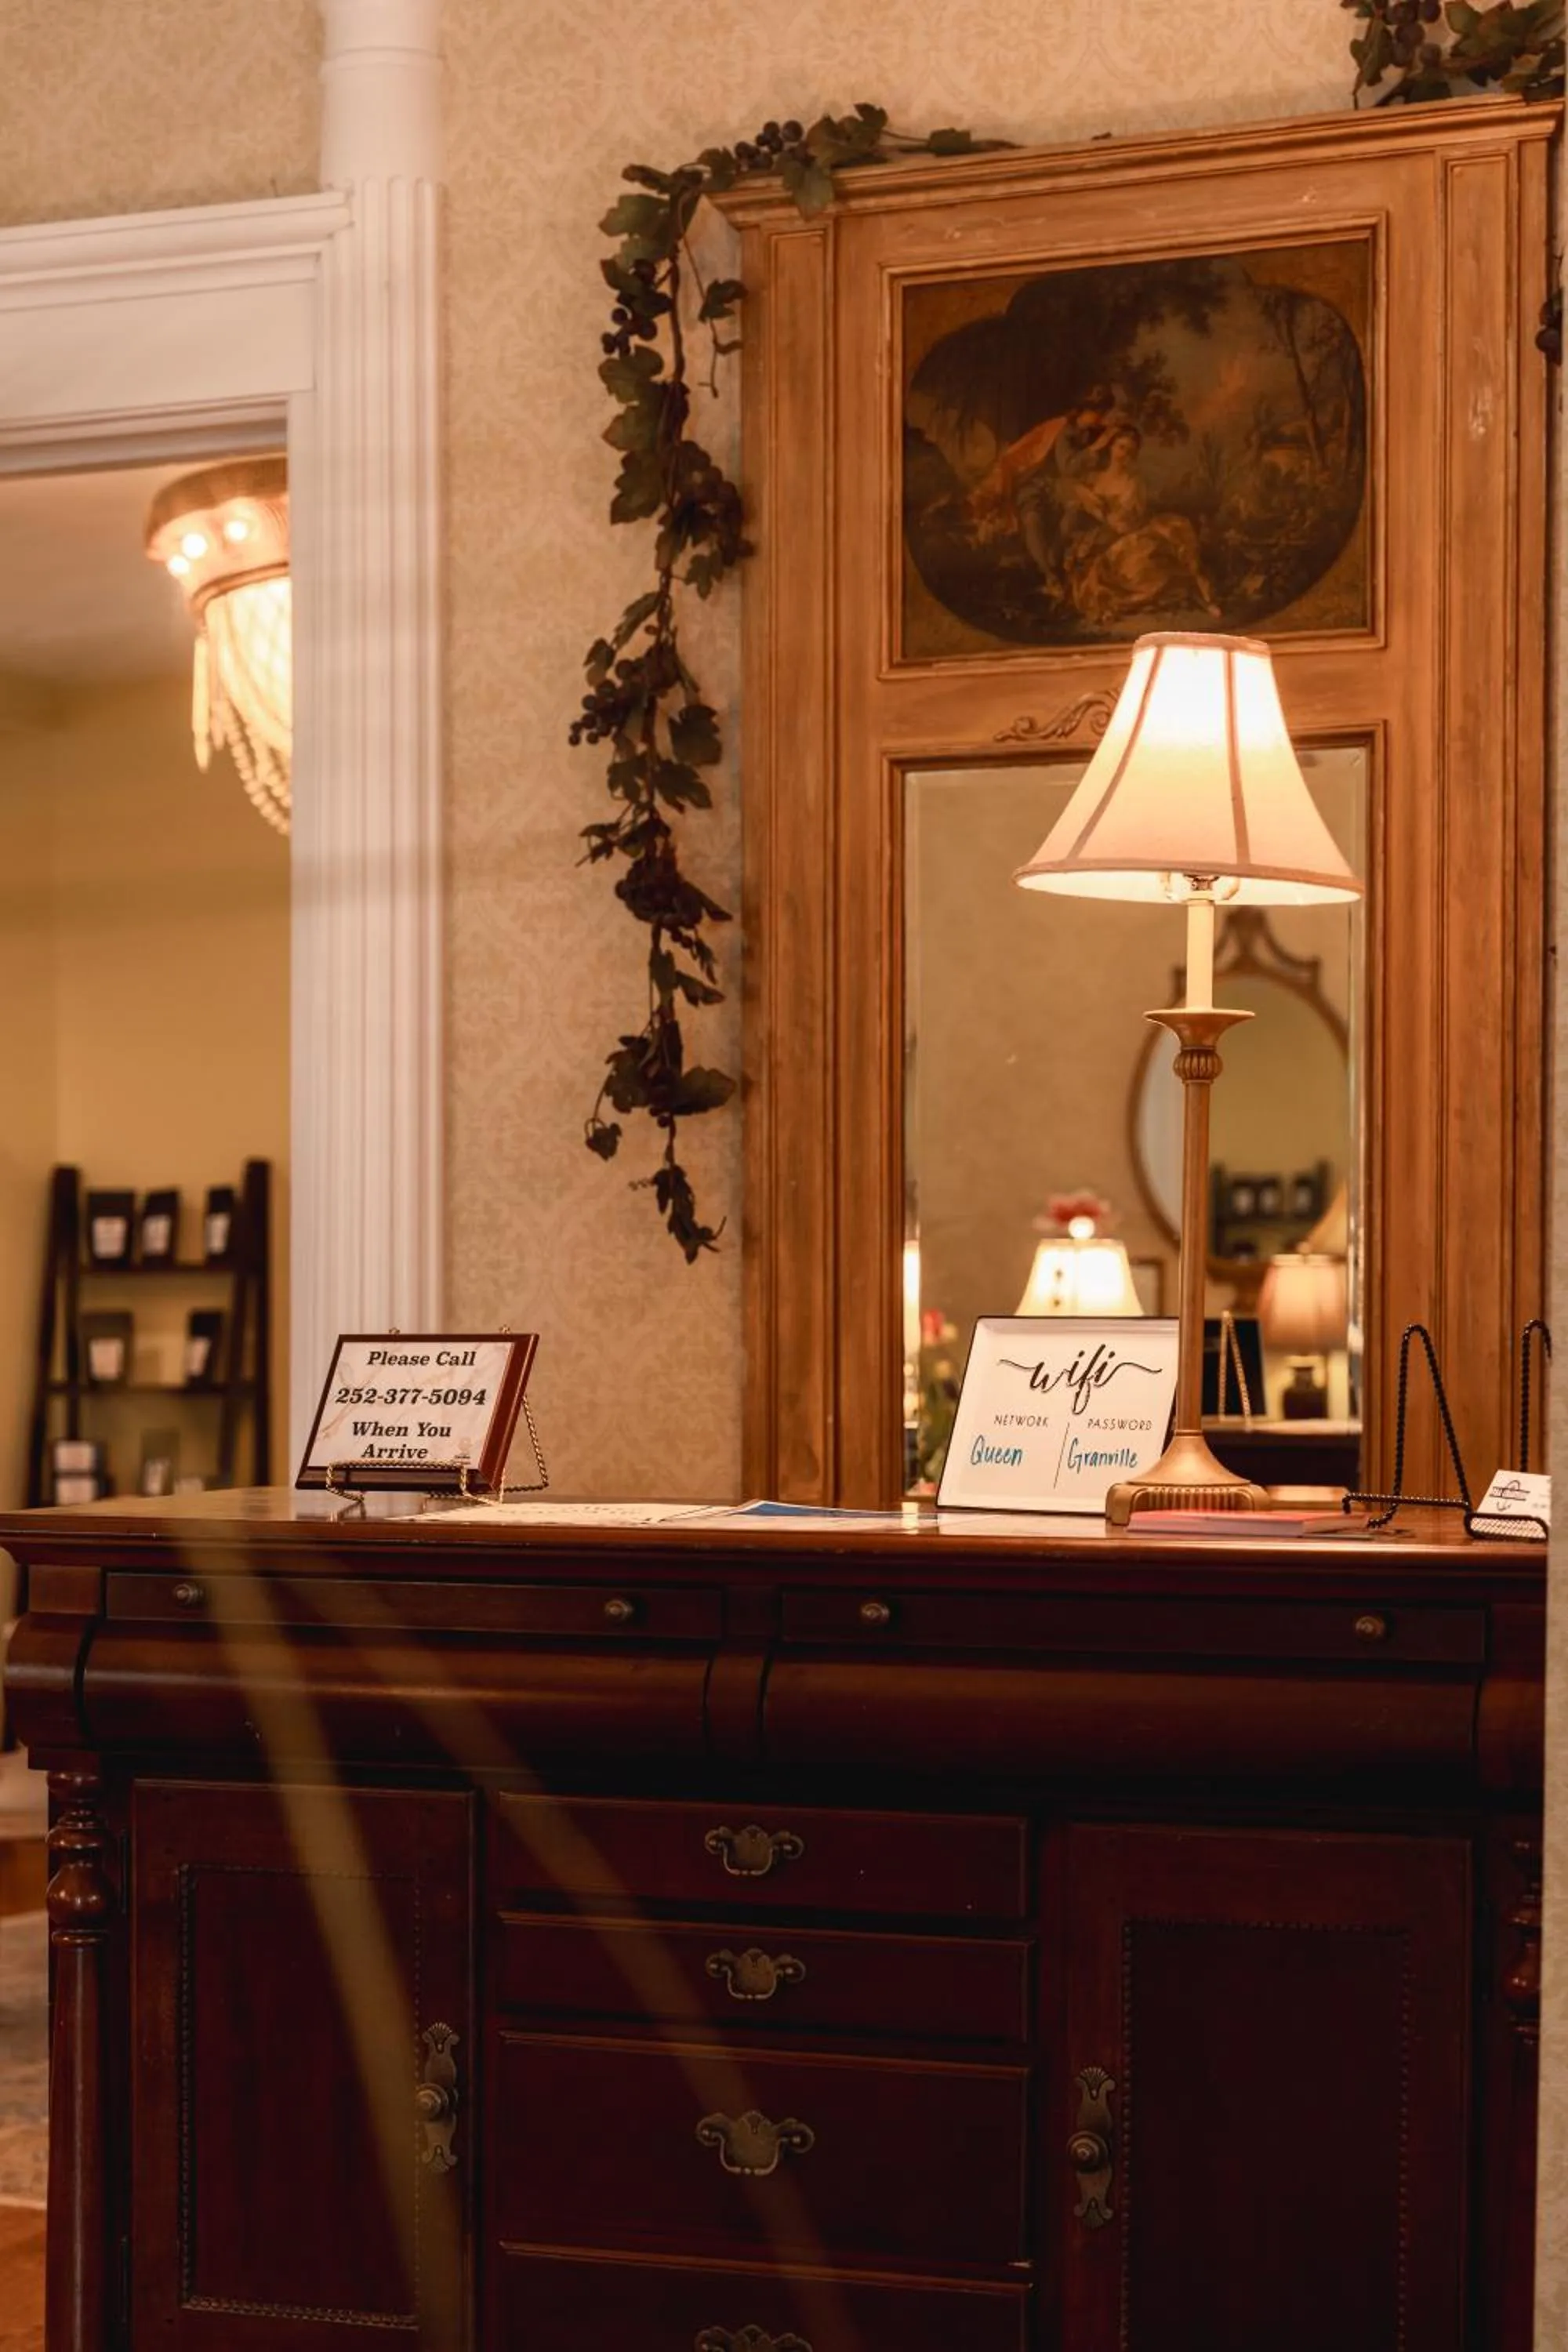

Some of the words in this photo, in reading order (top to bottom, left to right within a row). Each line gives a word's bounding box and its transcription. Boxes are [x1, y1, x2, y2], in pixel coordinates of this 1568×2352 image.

[366, 1351, 430, 1367] Please
[436, 1351, 476, 1367] Call
[997, 1343, 1163, 1415] wifi
[335, 1388, 487, 1406] 252-377-5094
[353, 1421, 408, 1437] When
[417, 1422, 451, 1437] You
[993, 1414, 1048, 1428] NETWORK
[1087, 1418, 1152, 1431] PASSWORD
[361, 1444, 428, 1458] Arrive
[971, 1435, 1022, 1466] Queen
[1067, 1437, 1138, 1473] Granville
